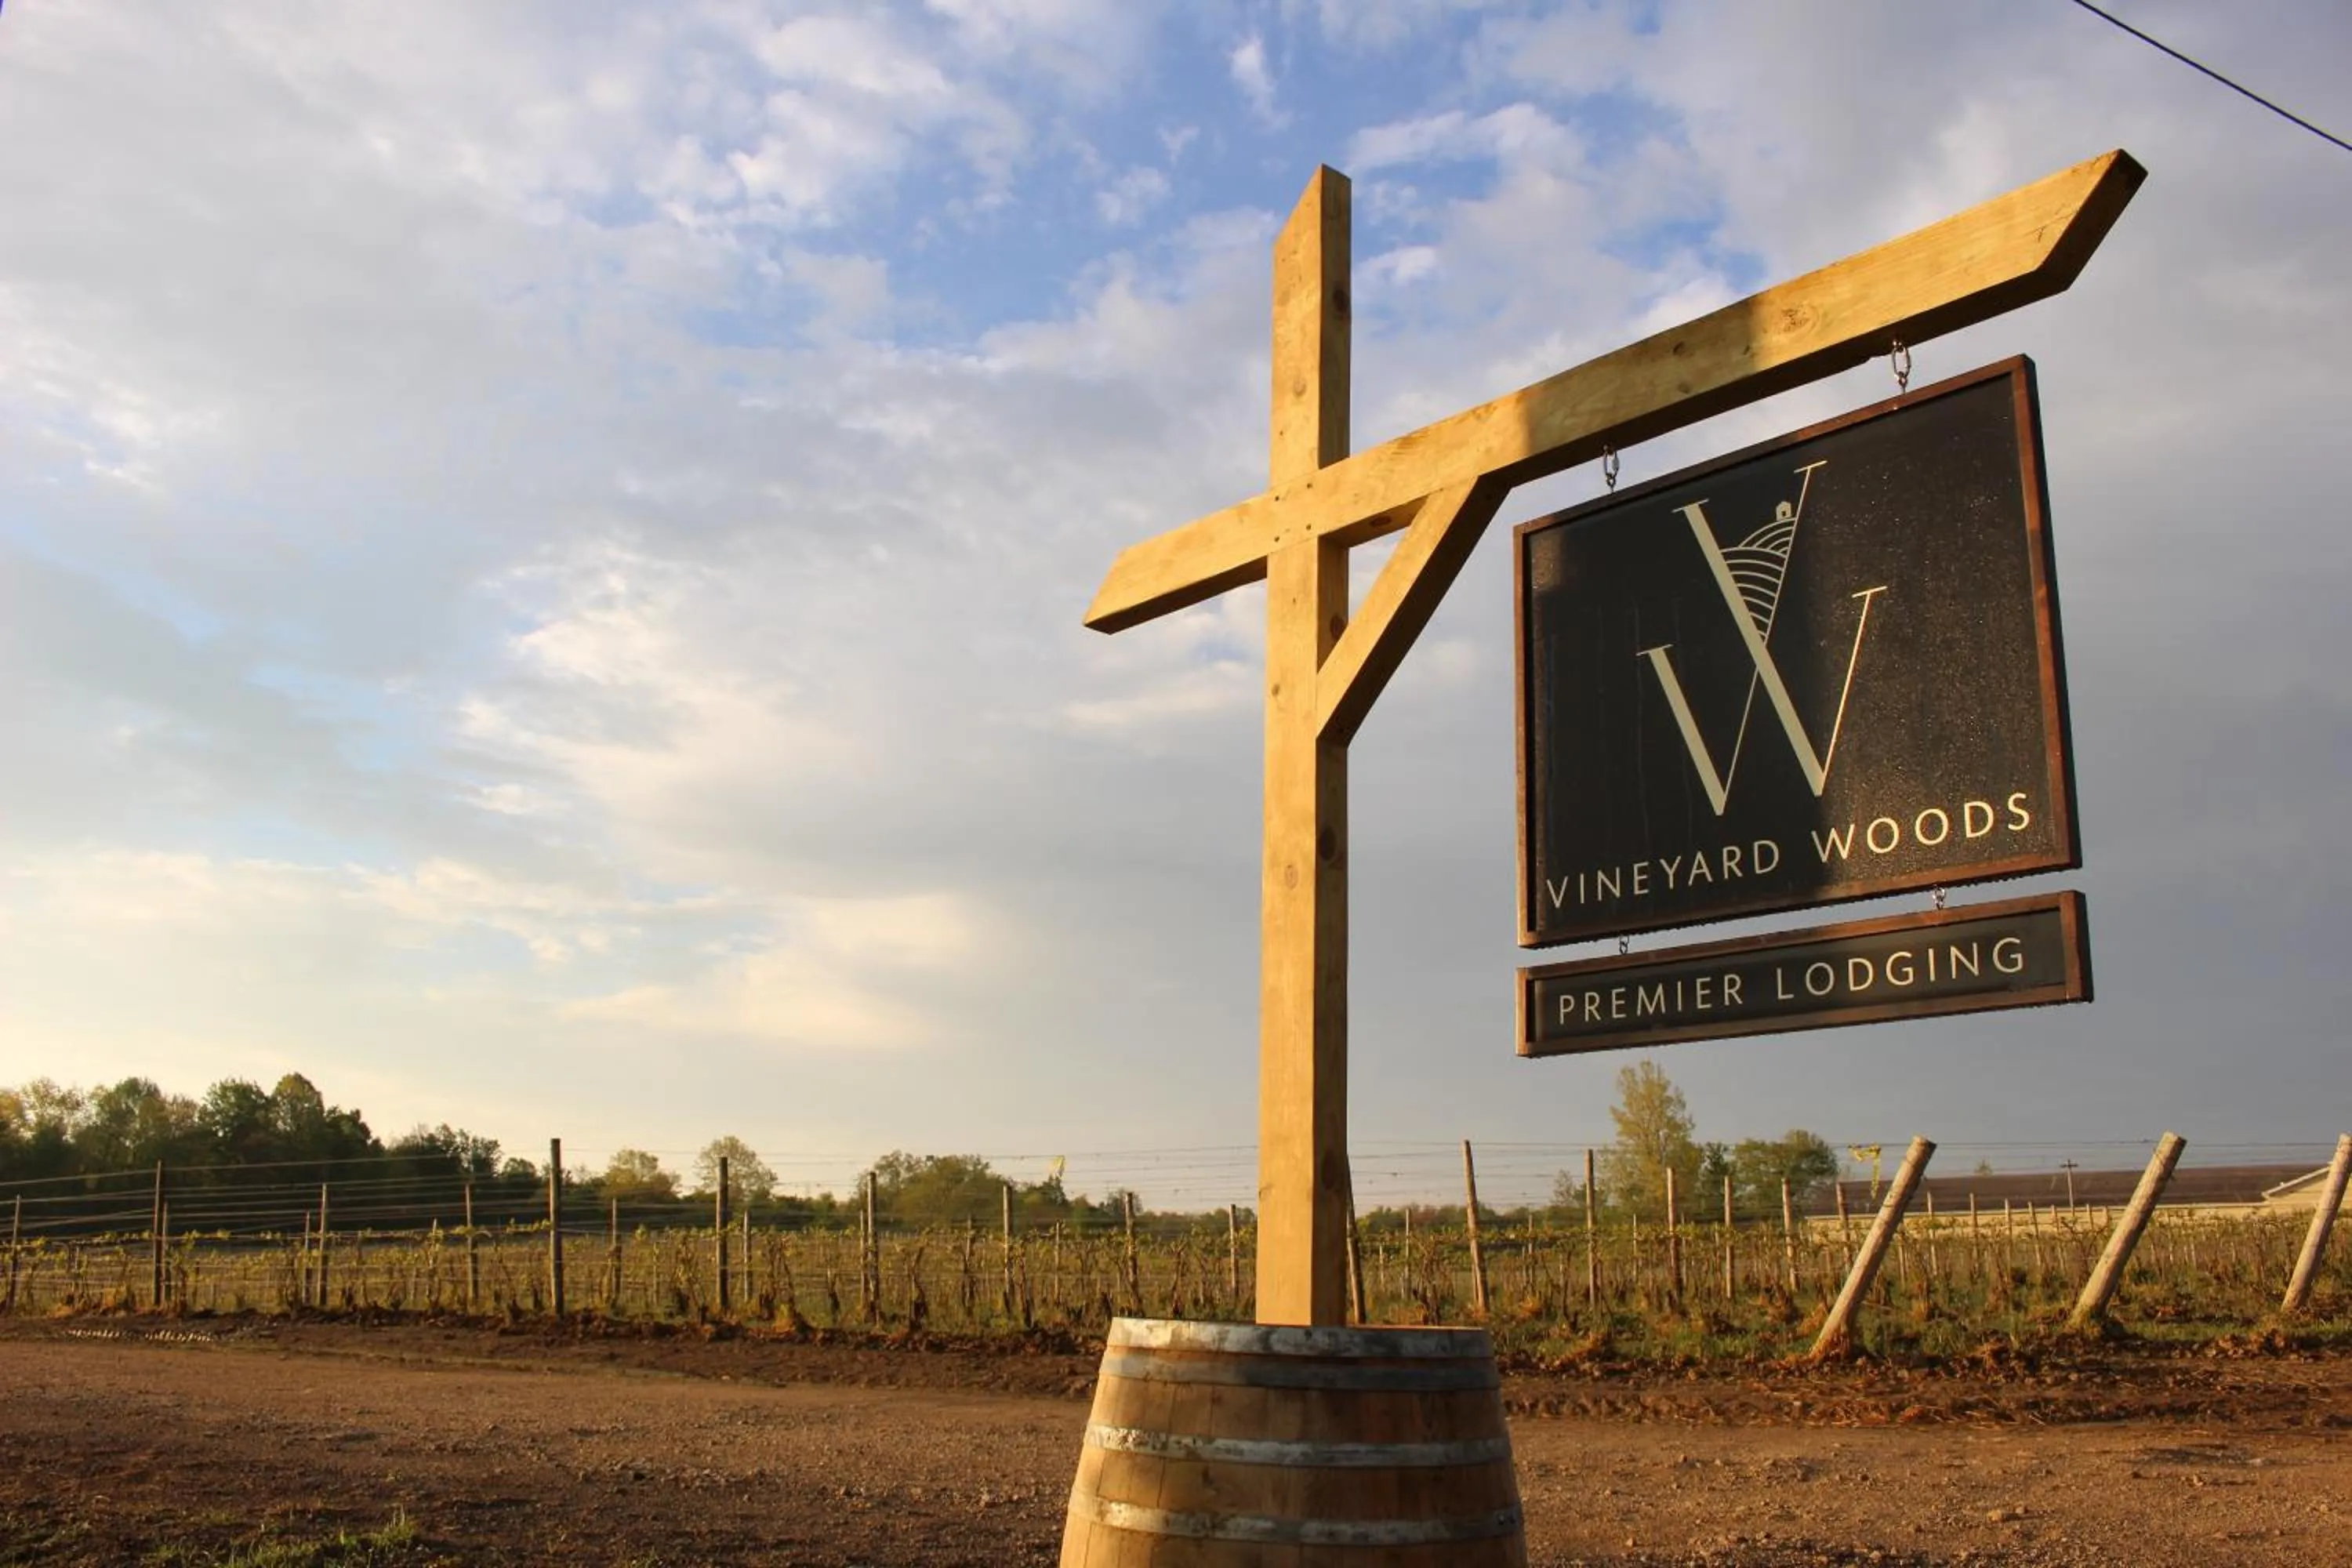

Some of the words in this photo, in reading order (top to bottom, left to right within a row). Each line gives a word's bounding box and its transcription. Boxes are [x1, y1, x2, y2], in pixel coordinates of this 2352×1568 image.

[1546, 839, 1780, 909] VINEYARD
[1811, 792, 2031, 864] WOODS
[1559, 975, 1744, 1025] PREMIER
[1776, 937, 2024, 1000] LODGING
